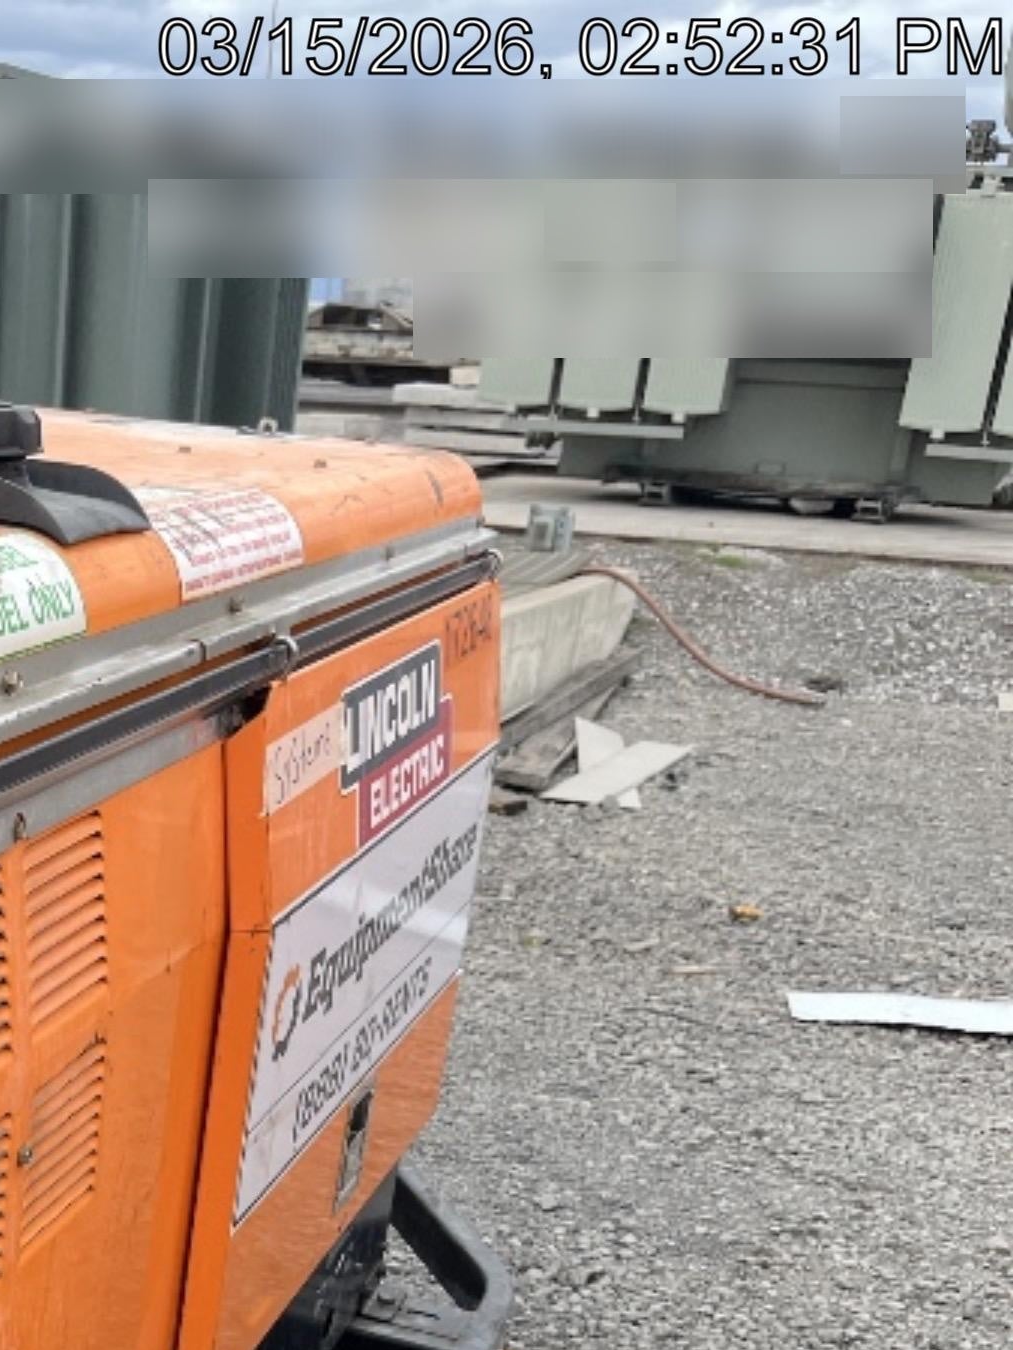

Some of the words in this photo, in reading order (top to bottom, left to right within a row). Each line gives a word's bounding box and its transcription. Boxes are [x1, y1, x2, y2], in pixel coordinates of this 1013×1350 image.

[29, 579, 77, 625] ONLY
[345, 659, 436, 776] LINCOLN
[370, 732, 445, 830] ELECTRIC
